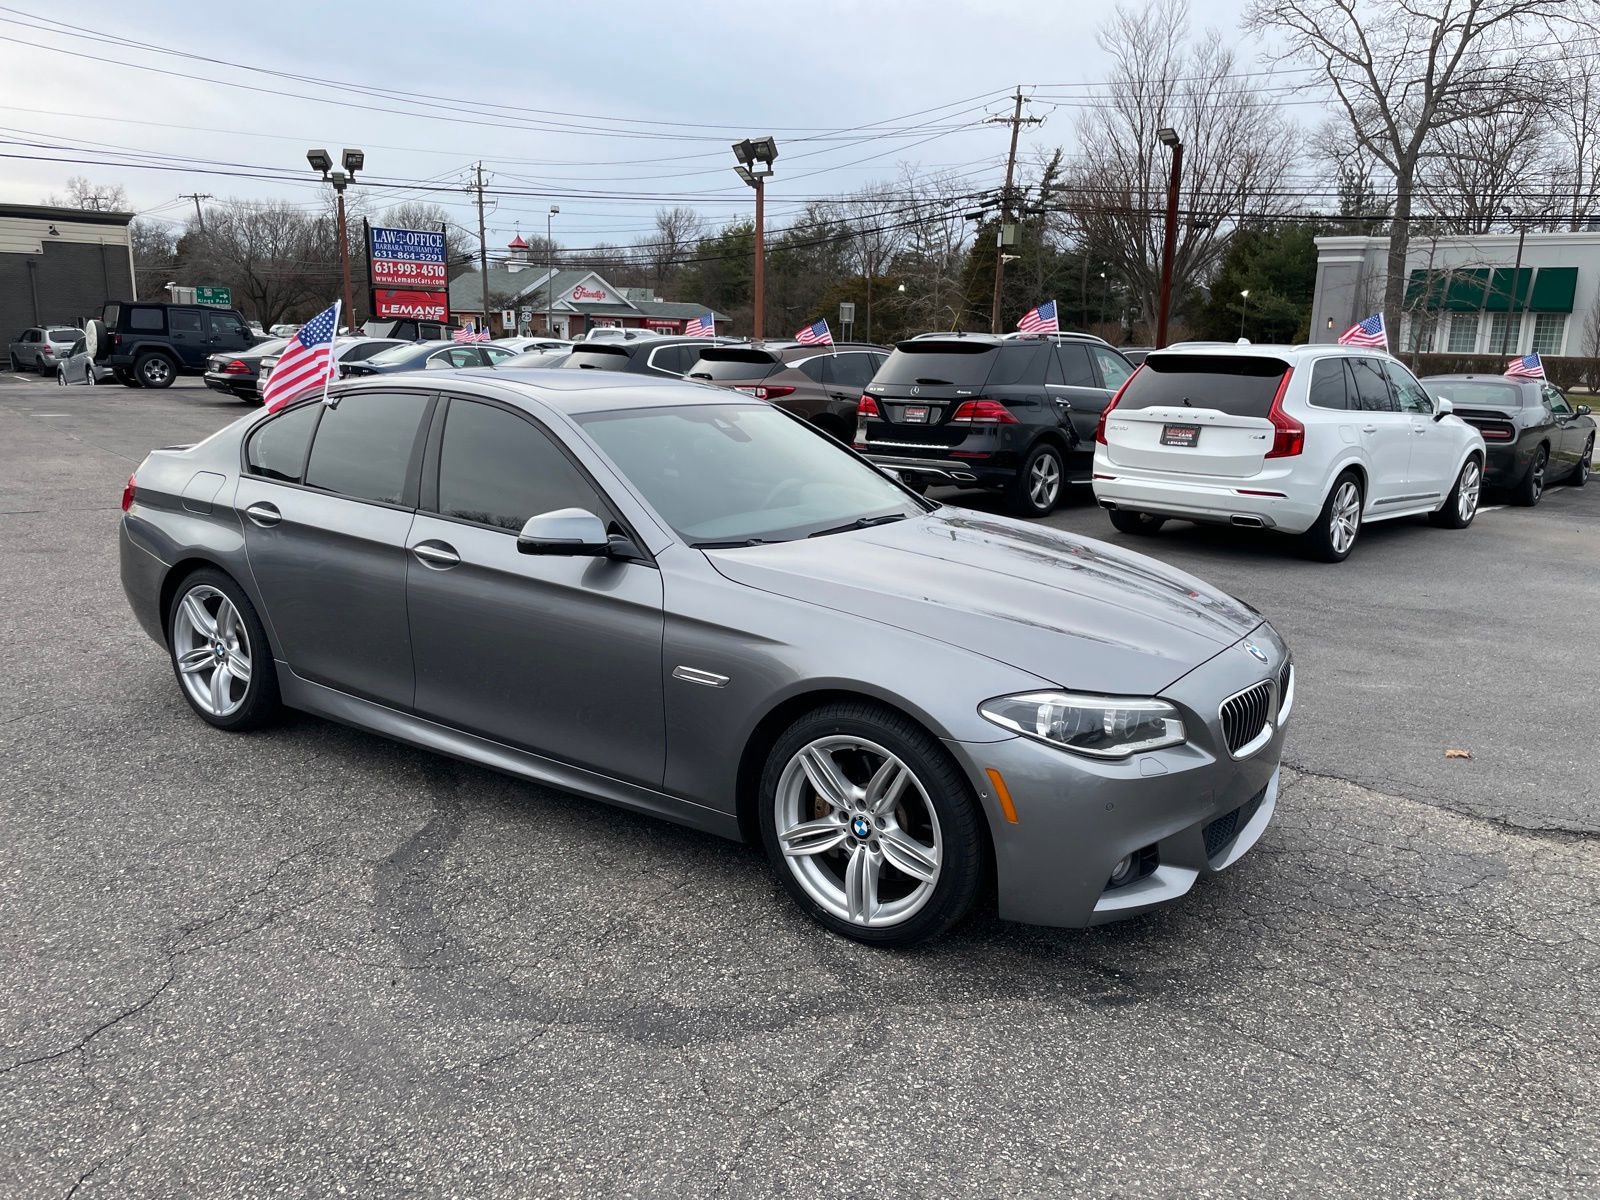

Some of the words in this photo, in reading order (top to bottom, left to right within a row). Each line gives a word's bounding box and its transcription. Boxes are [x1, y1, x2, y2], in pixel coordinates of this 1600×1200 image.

[373, 229, 397, 243] LAW
[406, 232, 443, 247] OFFICE
[375, 243, 403, 251] BARBARA
[404, 245, 433, 254] TOUHAMY
[374, 250, 443, 261] 631-864-5291
[375, 262, 445, 276] 631-993-4510
[375, 276, 445, 285] www.LemansCars.com
[381, 304, 445, 315] LEMANS
